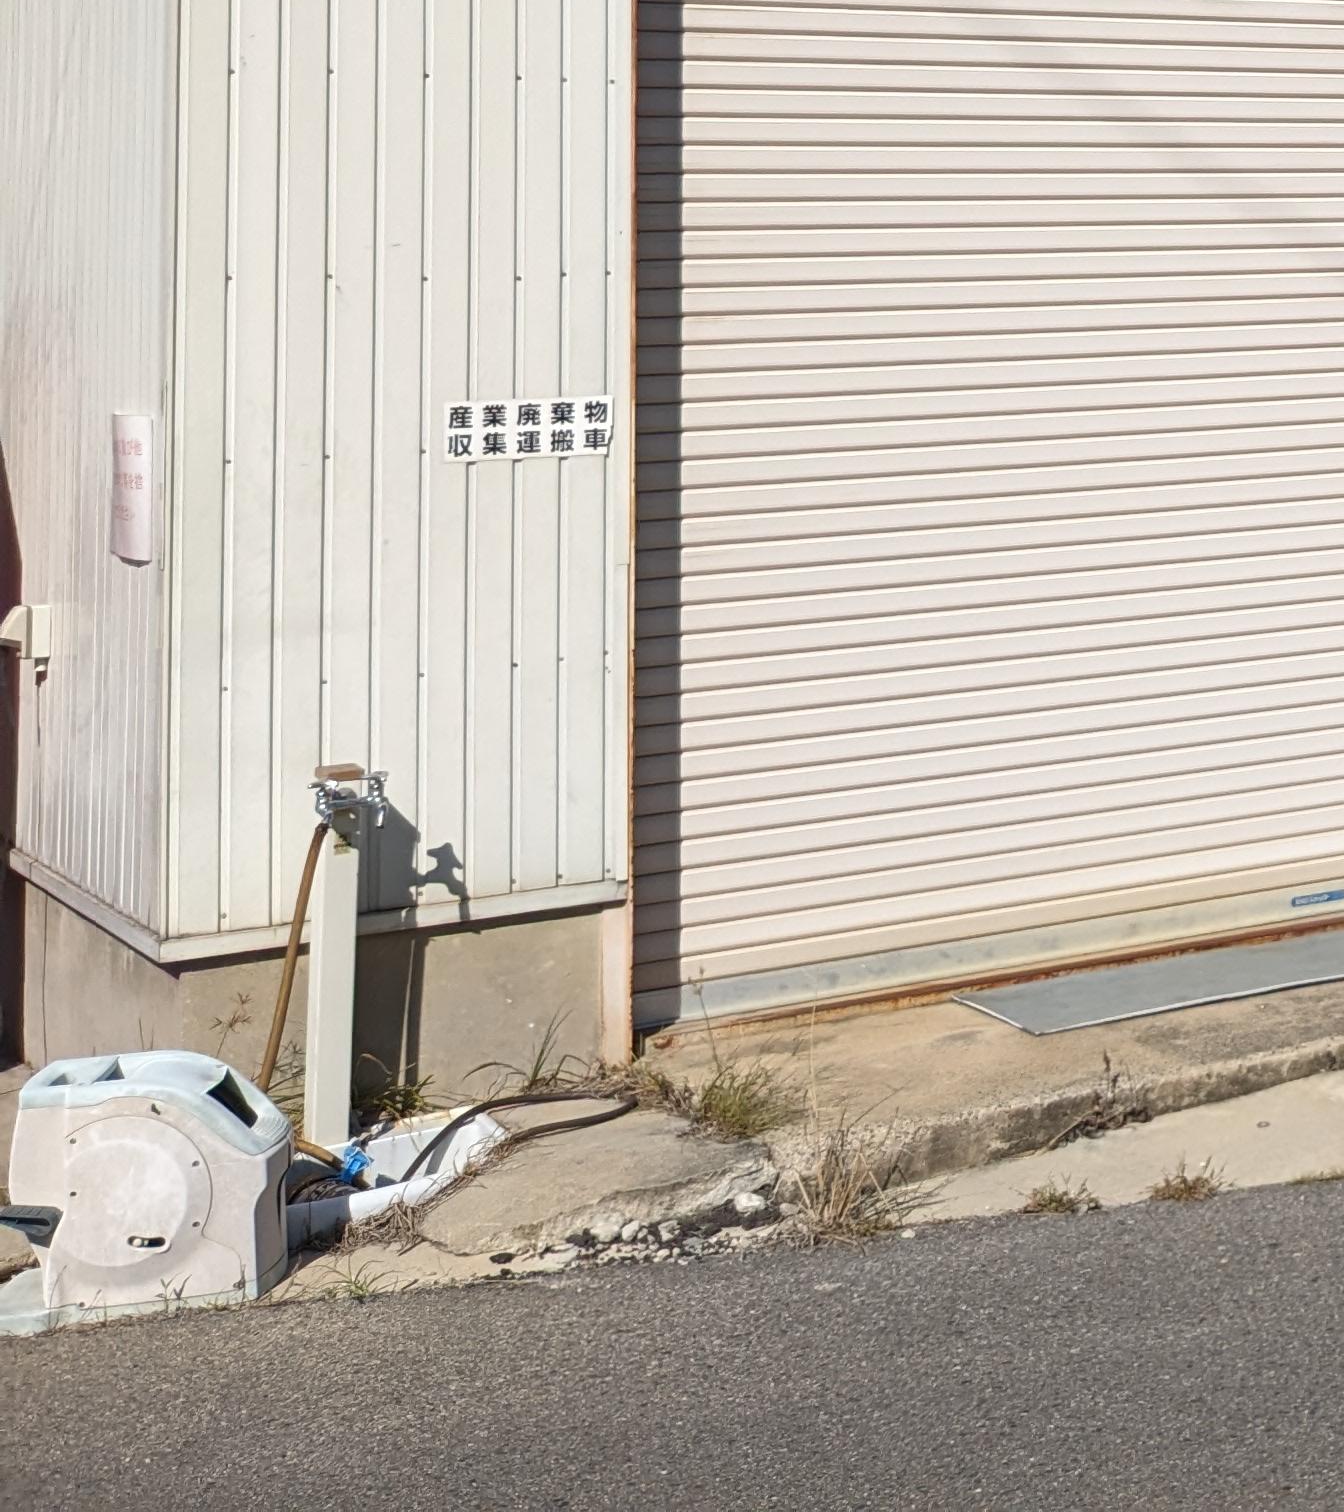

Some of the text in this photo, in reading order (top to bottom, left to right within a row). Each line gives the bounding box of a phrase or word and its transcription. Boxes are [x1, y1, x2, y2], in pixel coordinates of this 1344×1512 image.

[448, 400, 609, 429] 産業廃棄物
[447, 428, 610, 458] 収集運搬車
